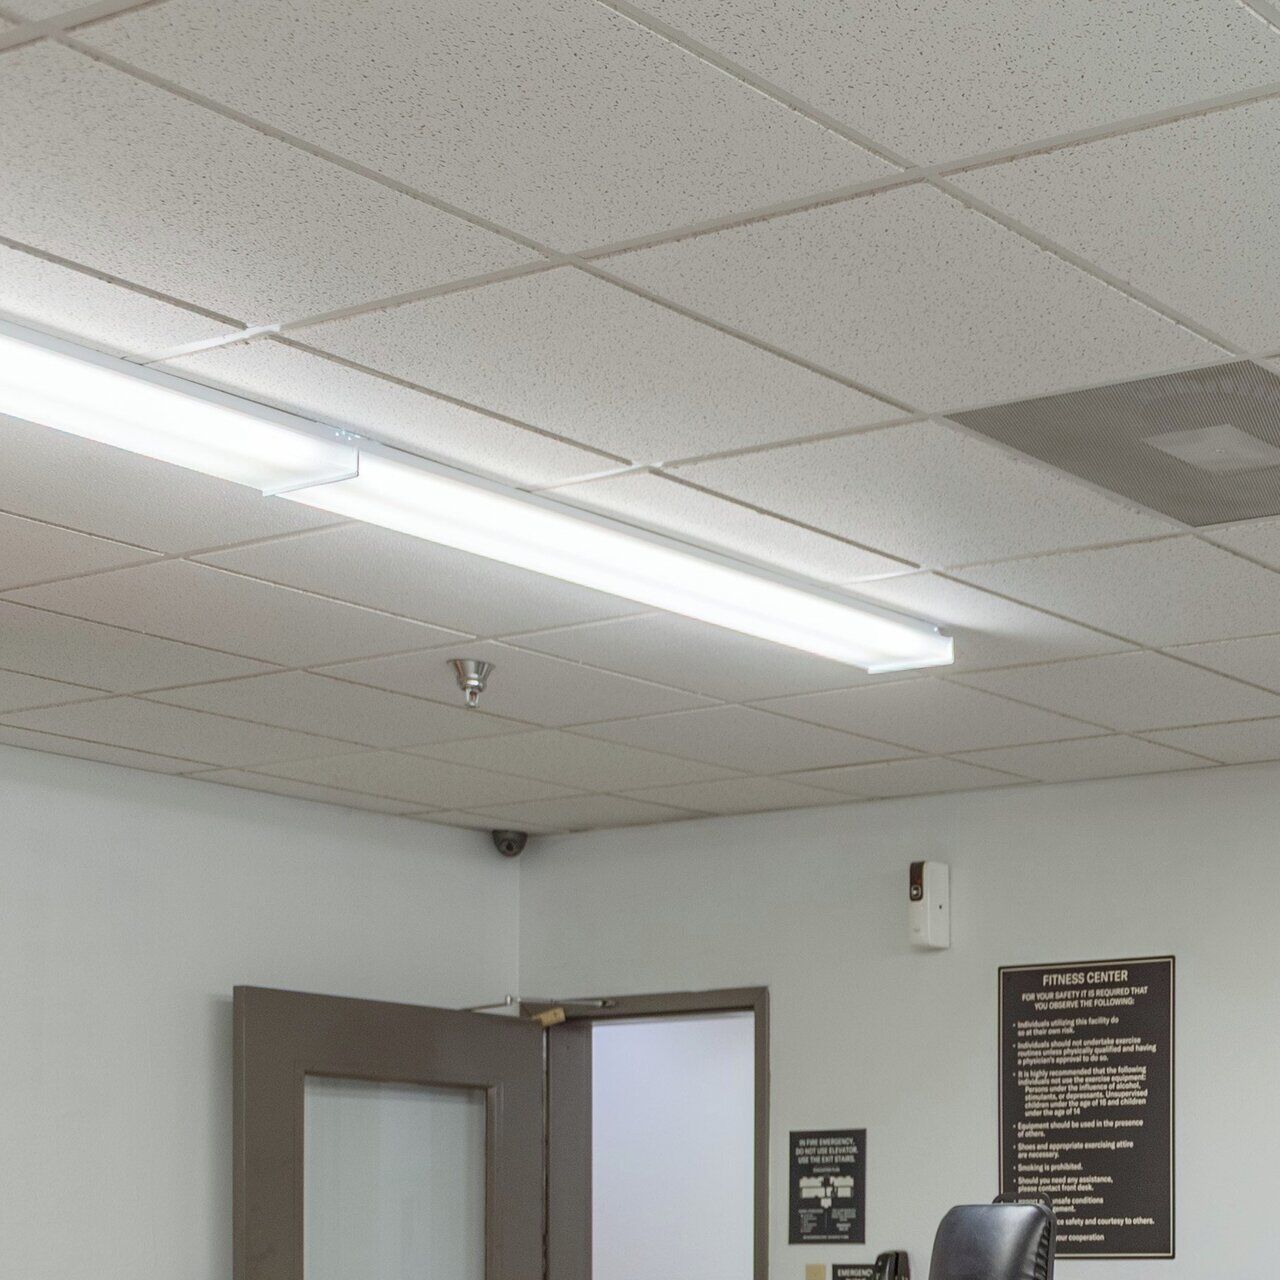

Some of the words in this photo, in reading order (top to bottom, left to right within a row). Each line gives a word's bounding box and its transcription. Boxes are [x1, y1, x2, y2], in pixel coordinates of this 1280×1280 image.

[1043, 972, 1085, 986] FITNESS
[1087, 970, 1128, 983] CENTER
[1022, 992, 1036, 1001] FOR
[1036, 991, 1054, 1001] YOUR
[1055, 990, 1080, 999] SAFETY
[1080, 989, 1087, 998] IT
[1088, 989, 1095, 997] IS
[1096, 987, 1129, 997] REQUIRED
[1131, 986, 1148, 995] THAT
[1035, 1002, 1048, 1010] YOU
[1050, 1000, 1079, 1009] OBSERVE
[1080, 1000, 1092, 1008] THE
[1093, 997, 1135, 1007] FOLLOWING:
[1066, 1218, 1084, 1226] safety
[1098, 1218, 1124, 1226] courtesy
[1133, 1216, 1154, 1224] others.
[1068, 1234, 1105, 1242] cooperation
